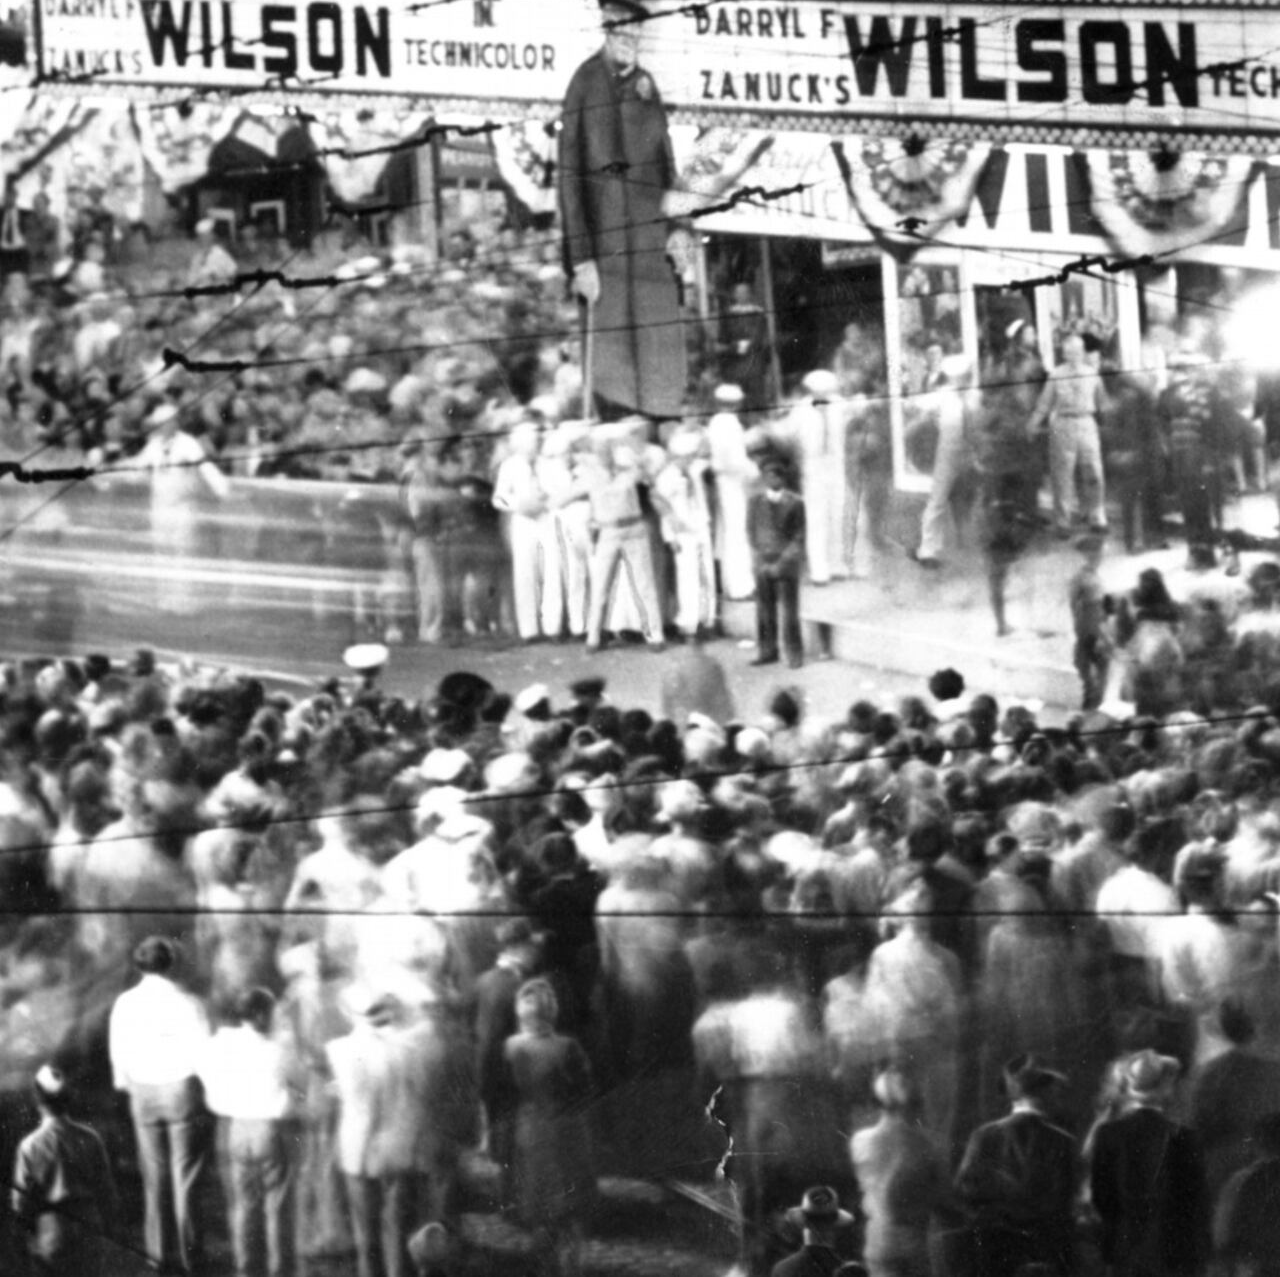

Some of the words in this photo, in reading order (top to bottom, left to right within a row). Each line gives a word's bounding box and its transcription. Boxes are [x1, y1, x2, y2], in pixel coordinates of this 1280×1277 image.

[694, 7, 806, 39] DARRYL
[404, 38, 557, 73] TECHNICOLOR
[842, 14, 1199, 108] WILSON
[700, 69, 851, 106] ZANUCK'S
